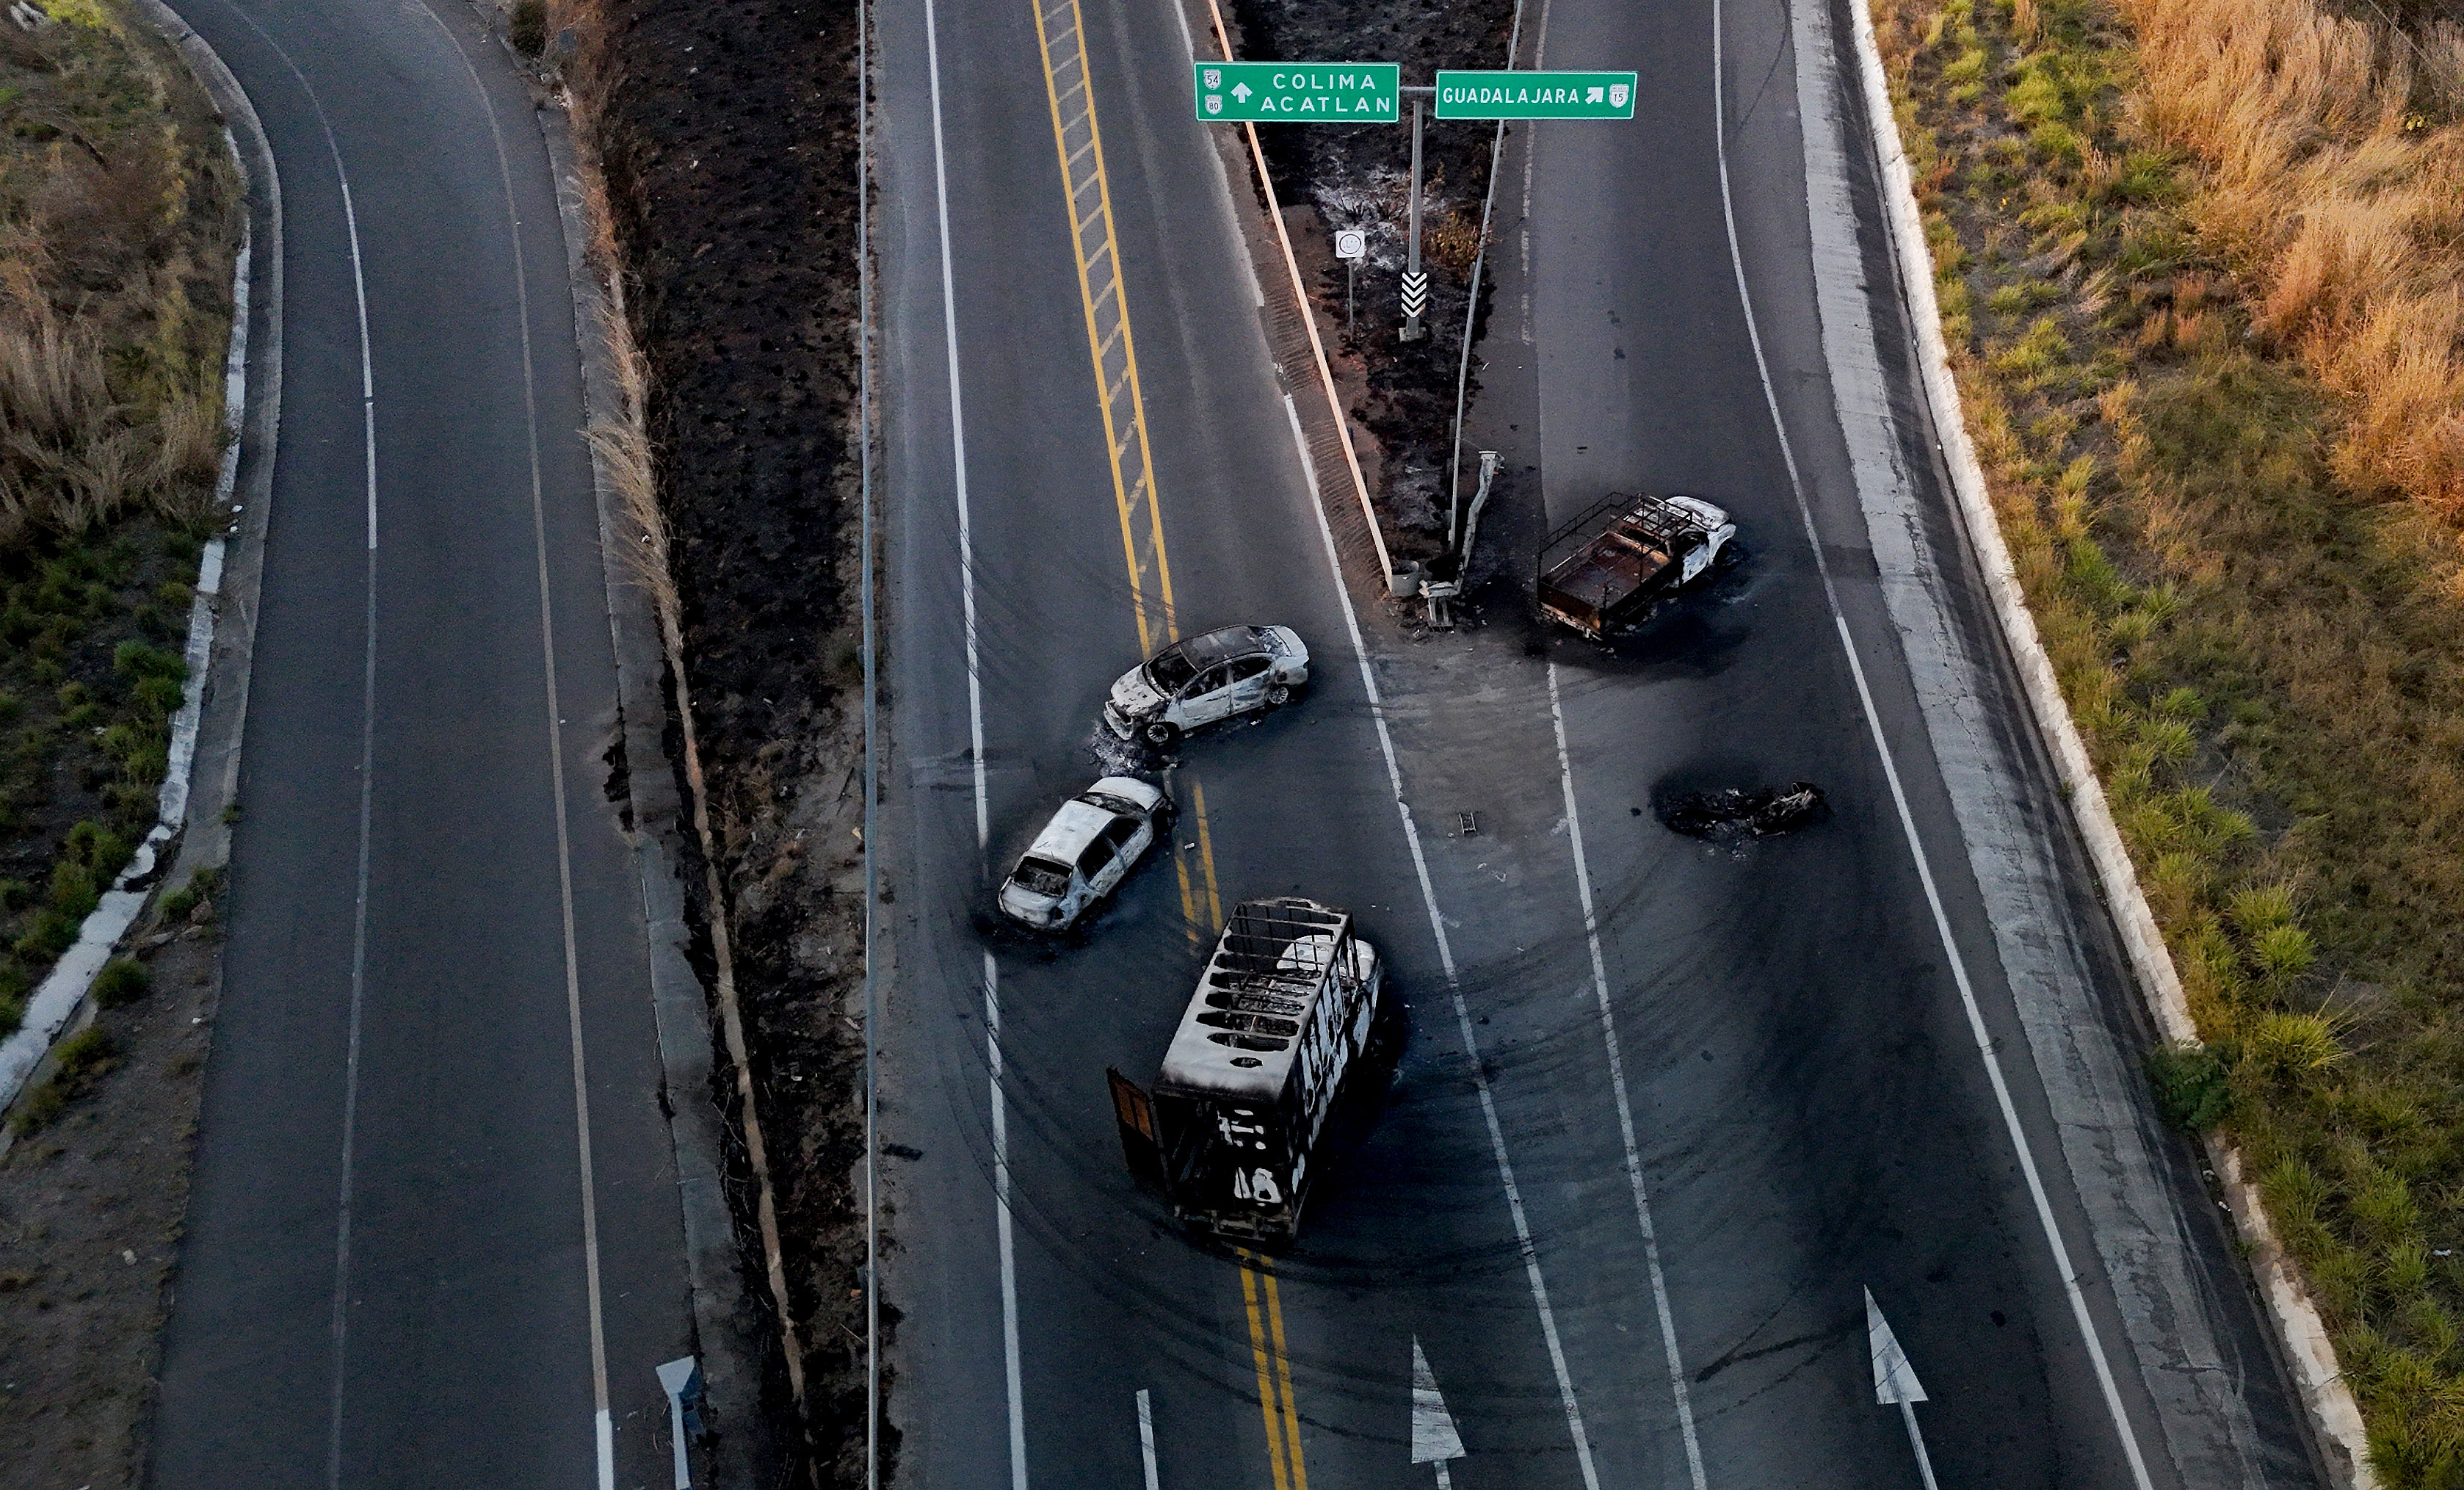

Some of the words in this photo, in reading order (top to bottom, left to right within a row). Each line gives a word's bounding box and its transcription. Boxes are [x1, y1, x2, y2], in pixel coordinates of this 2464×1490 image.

[1207, 75, 1218, 84] 54
[1272, 73, 1376, 90] COLIMA
[1443, 87, 1579, 104] GUADALAJARA
[1614, 93, 1623, 102] 15
[1209, 102, 1219, 110] 80
[1260, 96, 1390, 112] ACATLAN
